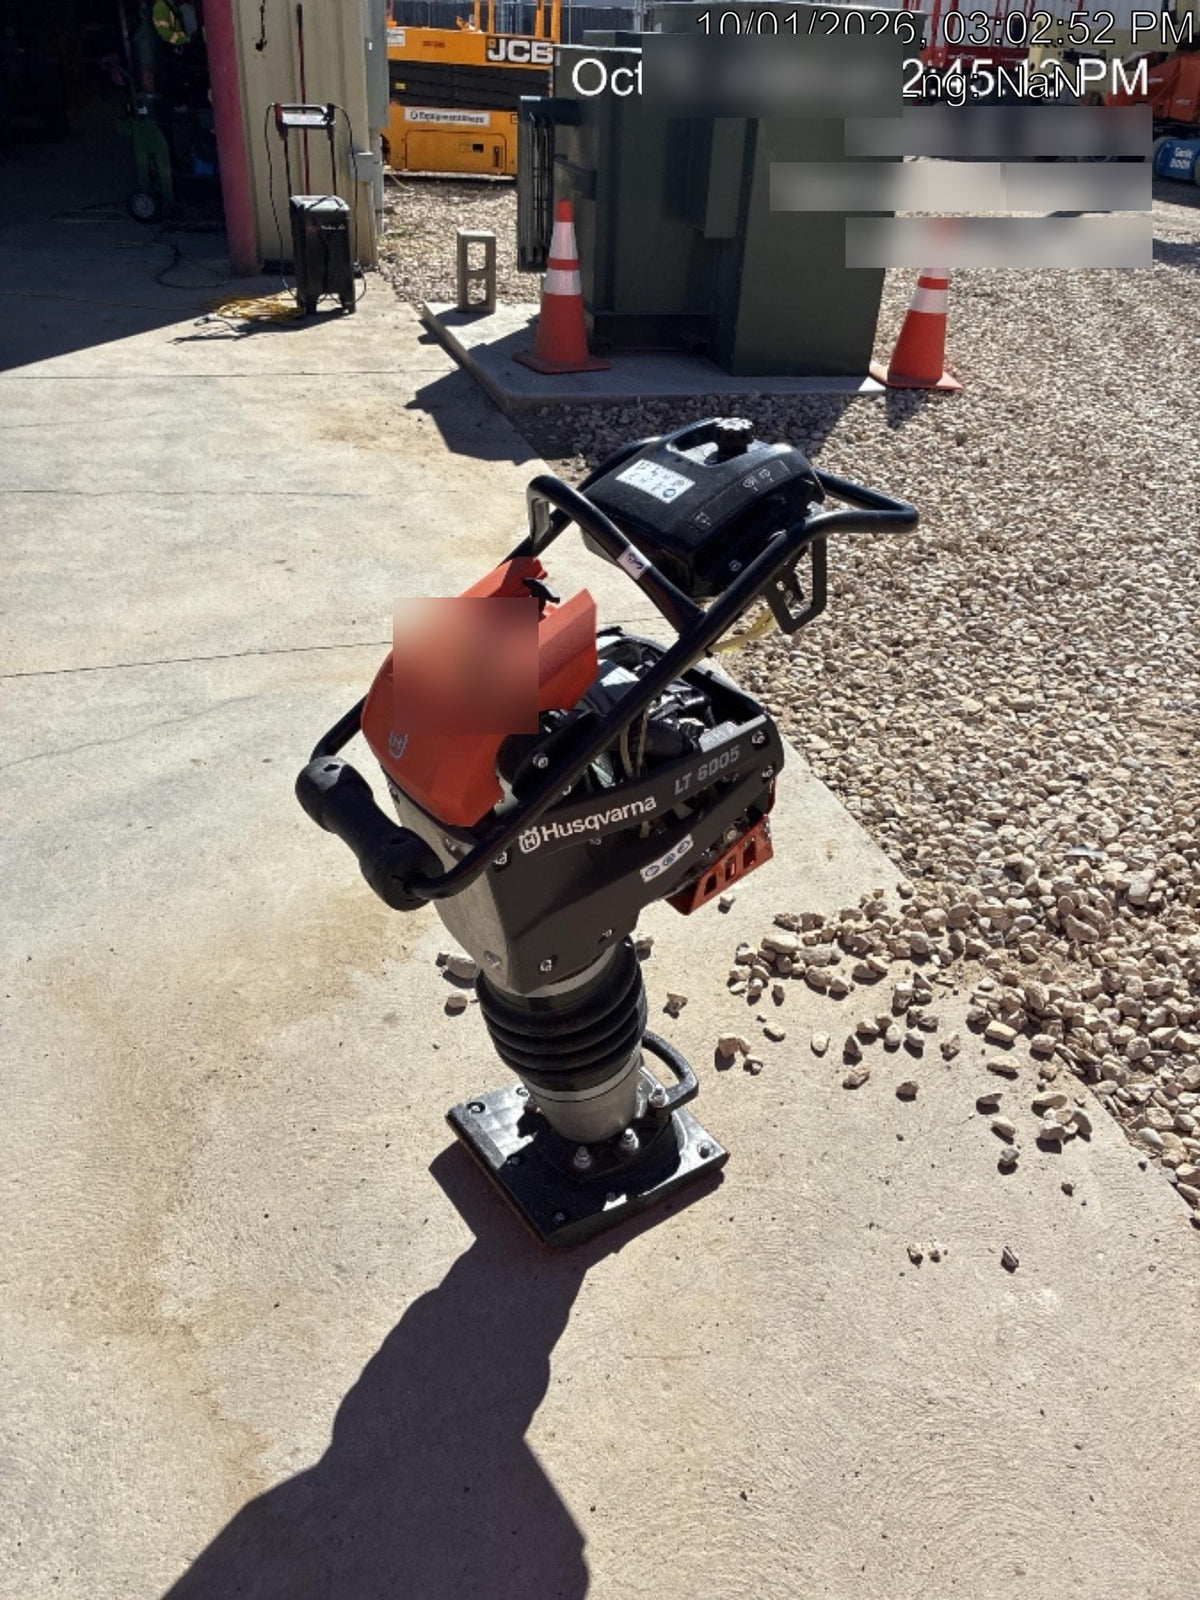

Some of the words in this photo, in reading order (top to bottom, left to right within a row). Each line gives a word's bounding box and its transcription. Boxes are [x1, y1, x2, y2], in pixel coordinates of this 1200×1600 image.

[487, 37, 554, 64] JCB
[674, 772, 693, 795] LT
[698, 745, 741, 781] 6005
[541, 796, 657, 842] Husqvarna
